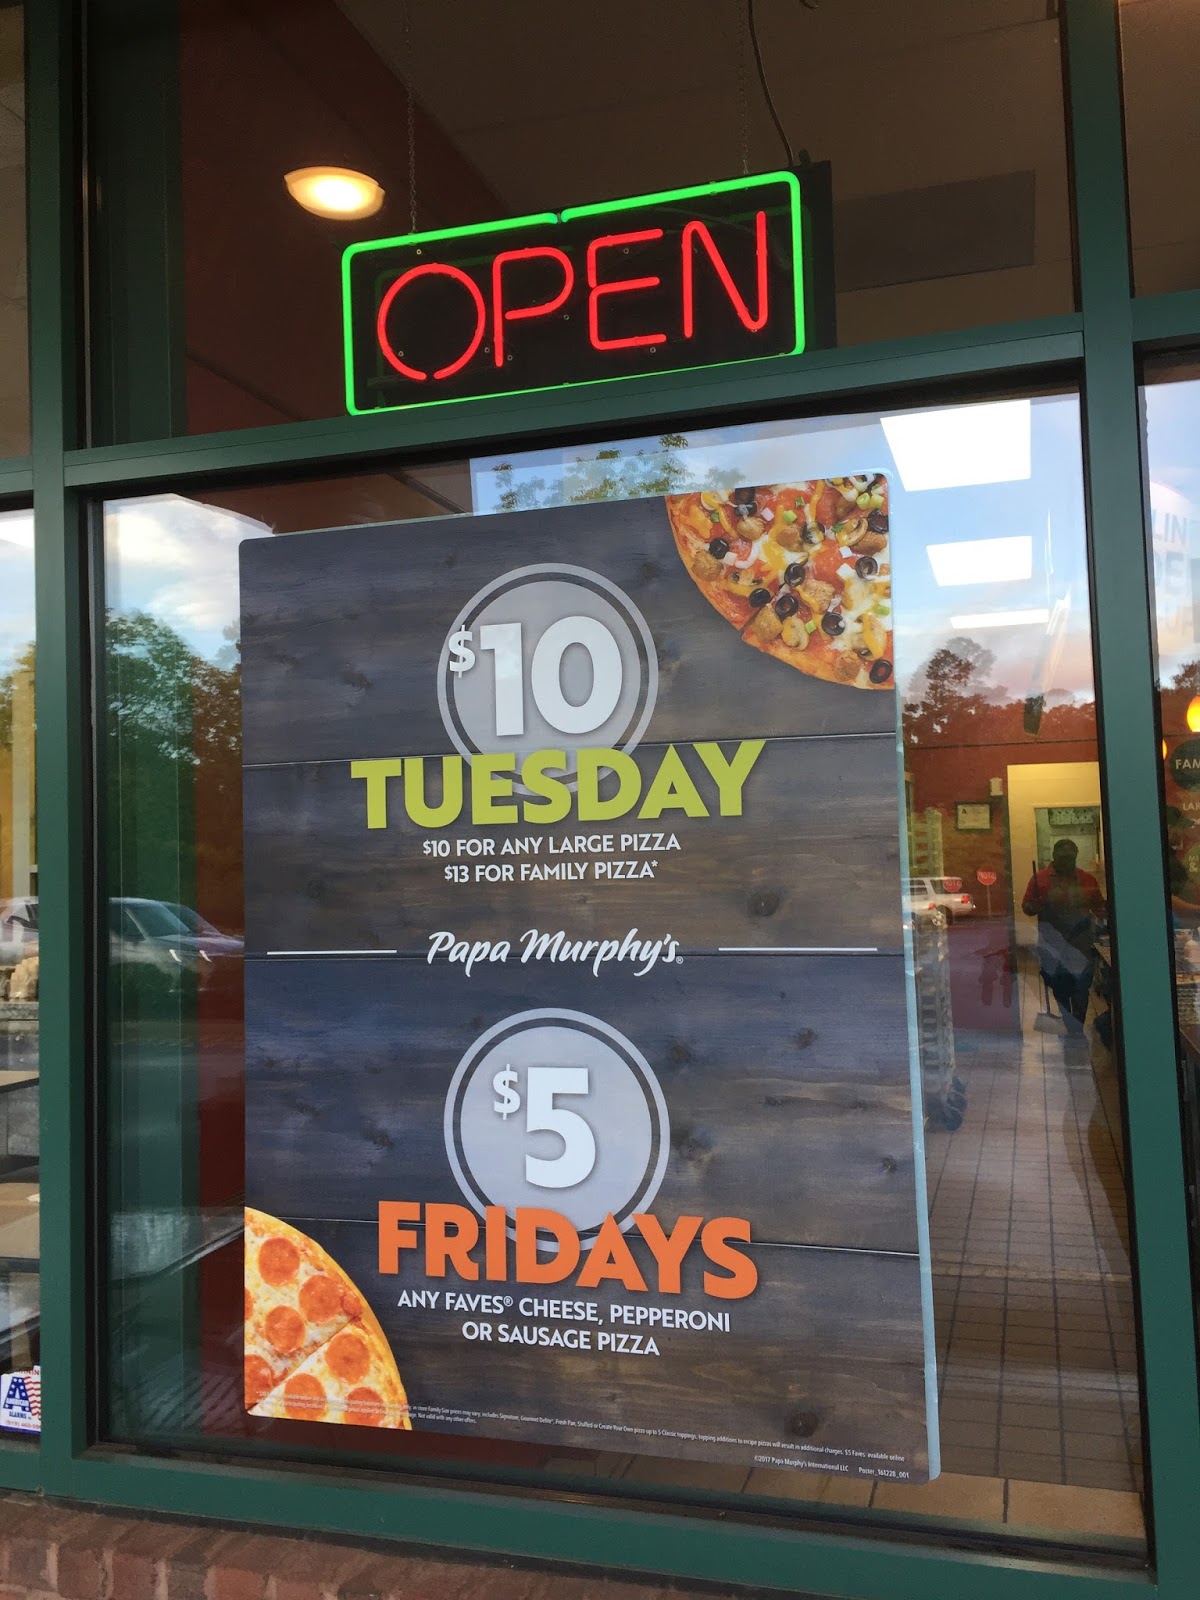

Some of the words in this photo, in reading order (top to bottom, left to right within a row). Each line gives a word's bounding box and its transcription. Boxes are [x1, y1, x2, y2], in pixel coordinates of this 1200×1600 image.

[377, 210, 769, 381] OPEN
[448, 615, 622, 736] $10
[351, 740, 767, 829] TUESDAY
[422, 839, 451, 858] $10
[456, 838, 495, 857] FOR
[500, 836, 543, 855] ANY
[549, 834, 614, 854] LARGE
[620, 832, 682, 852] PIZZA
[444, 864, 470, 883] $13
[475, 863, 514, 882] FOR
[520, 861, 590, 881] FAMILY
[426, 931, 511, 978] Papa
[492, 1063, 596, 1188] $5
[378, 1200, 758, 1299] FRIDAYS
[397, 1289, 440, 1309] ANY
[518, 1297, 603, 1325] CHEESE,
[610, 1304, 731, 1332] PEPPERONI
[462, 1321, 493, 1341] OR
[498, 1324, 591, 1350] SAUSAGE
[598, 1331, 660, 1356] PIZZA
[771, 1457, 784, 1465] Papa
[784, 1458, 807, 1468] Murphy's
[807, 1461, 840, 1471] International
[840, 1464, 849, 1472] LLC
[801, 1444, 824, 1452] additional
